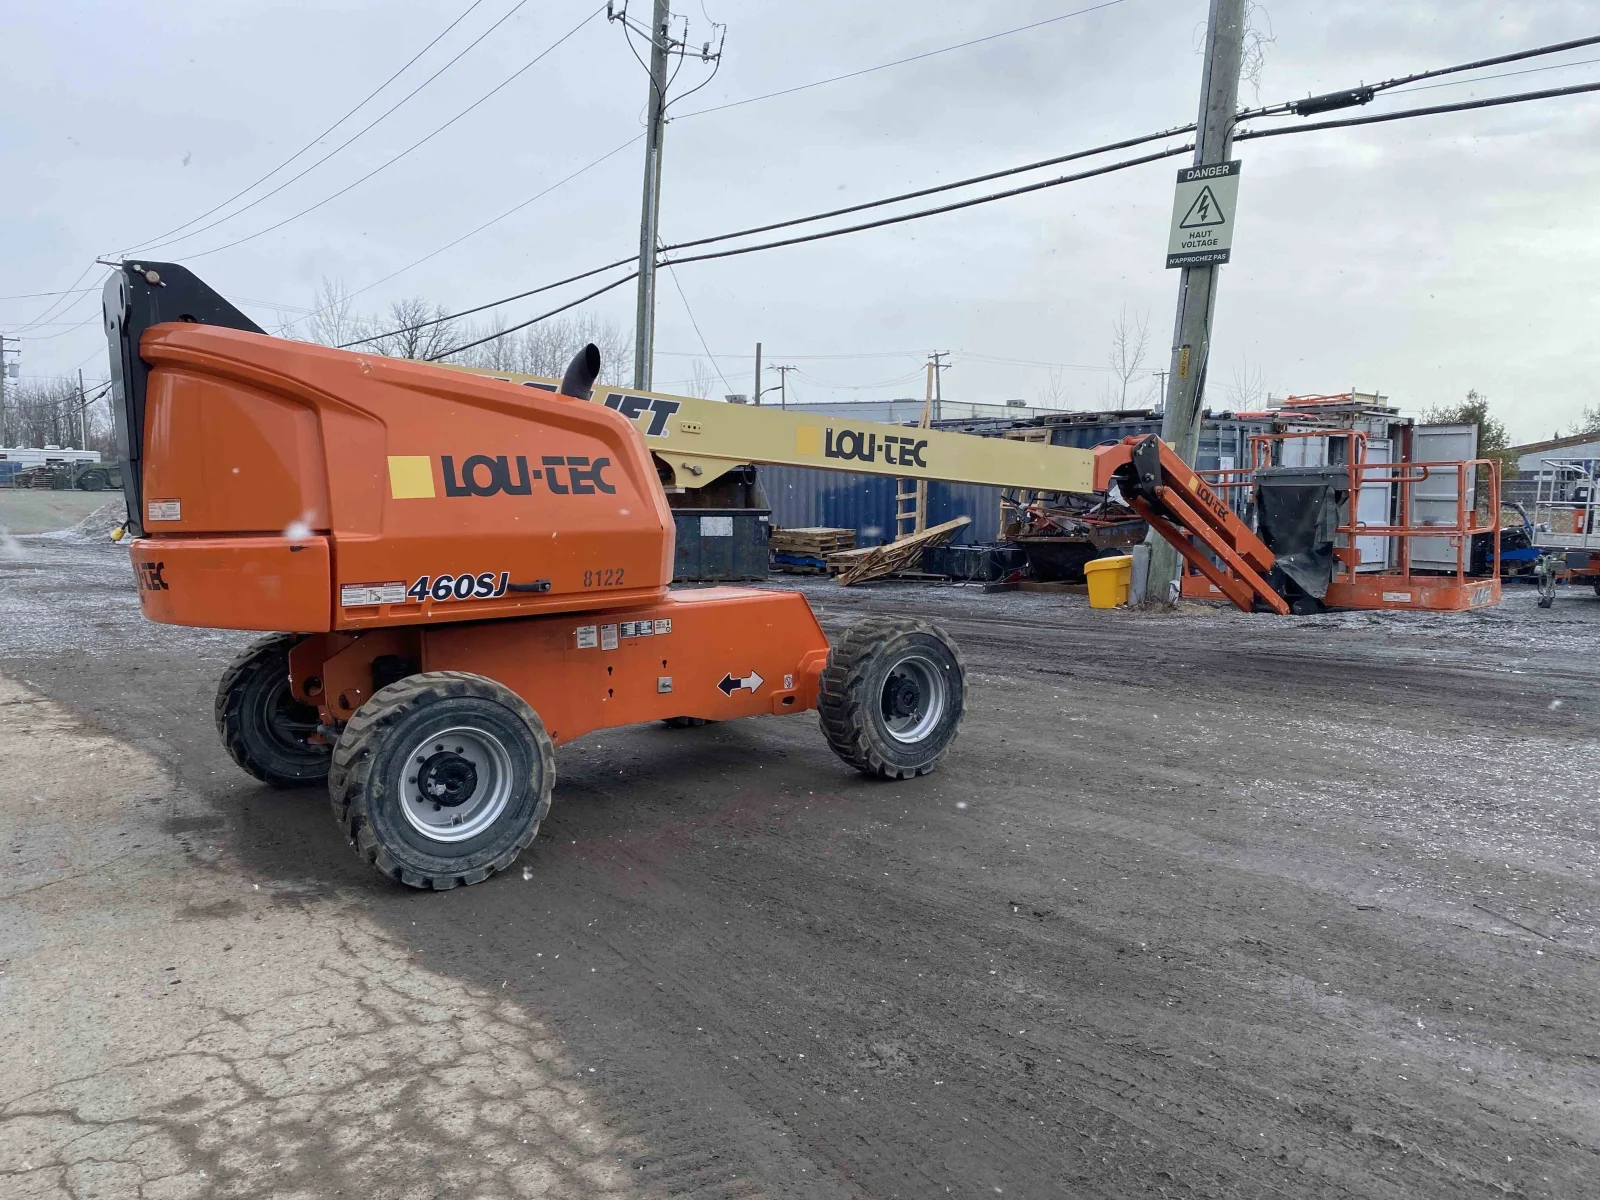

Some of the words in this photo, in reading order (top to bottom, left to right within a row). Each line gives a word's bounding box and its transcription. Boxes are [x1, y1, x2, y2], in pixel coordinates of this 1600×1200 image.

[1187, 165, 1230, 180] DANGER
[1189, 230, 1213, 239] HAUT
[1181, 238, 1219, 249] VOLTAGE
[1169, 254, 1213, 265] N'APPROCHEZ
[583, 567, 625, 588] 8122
[406, 571, 510, 602] 460SJ
